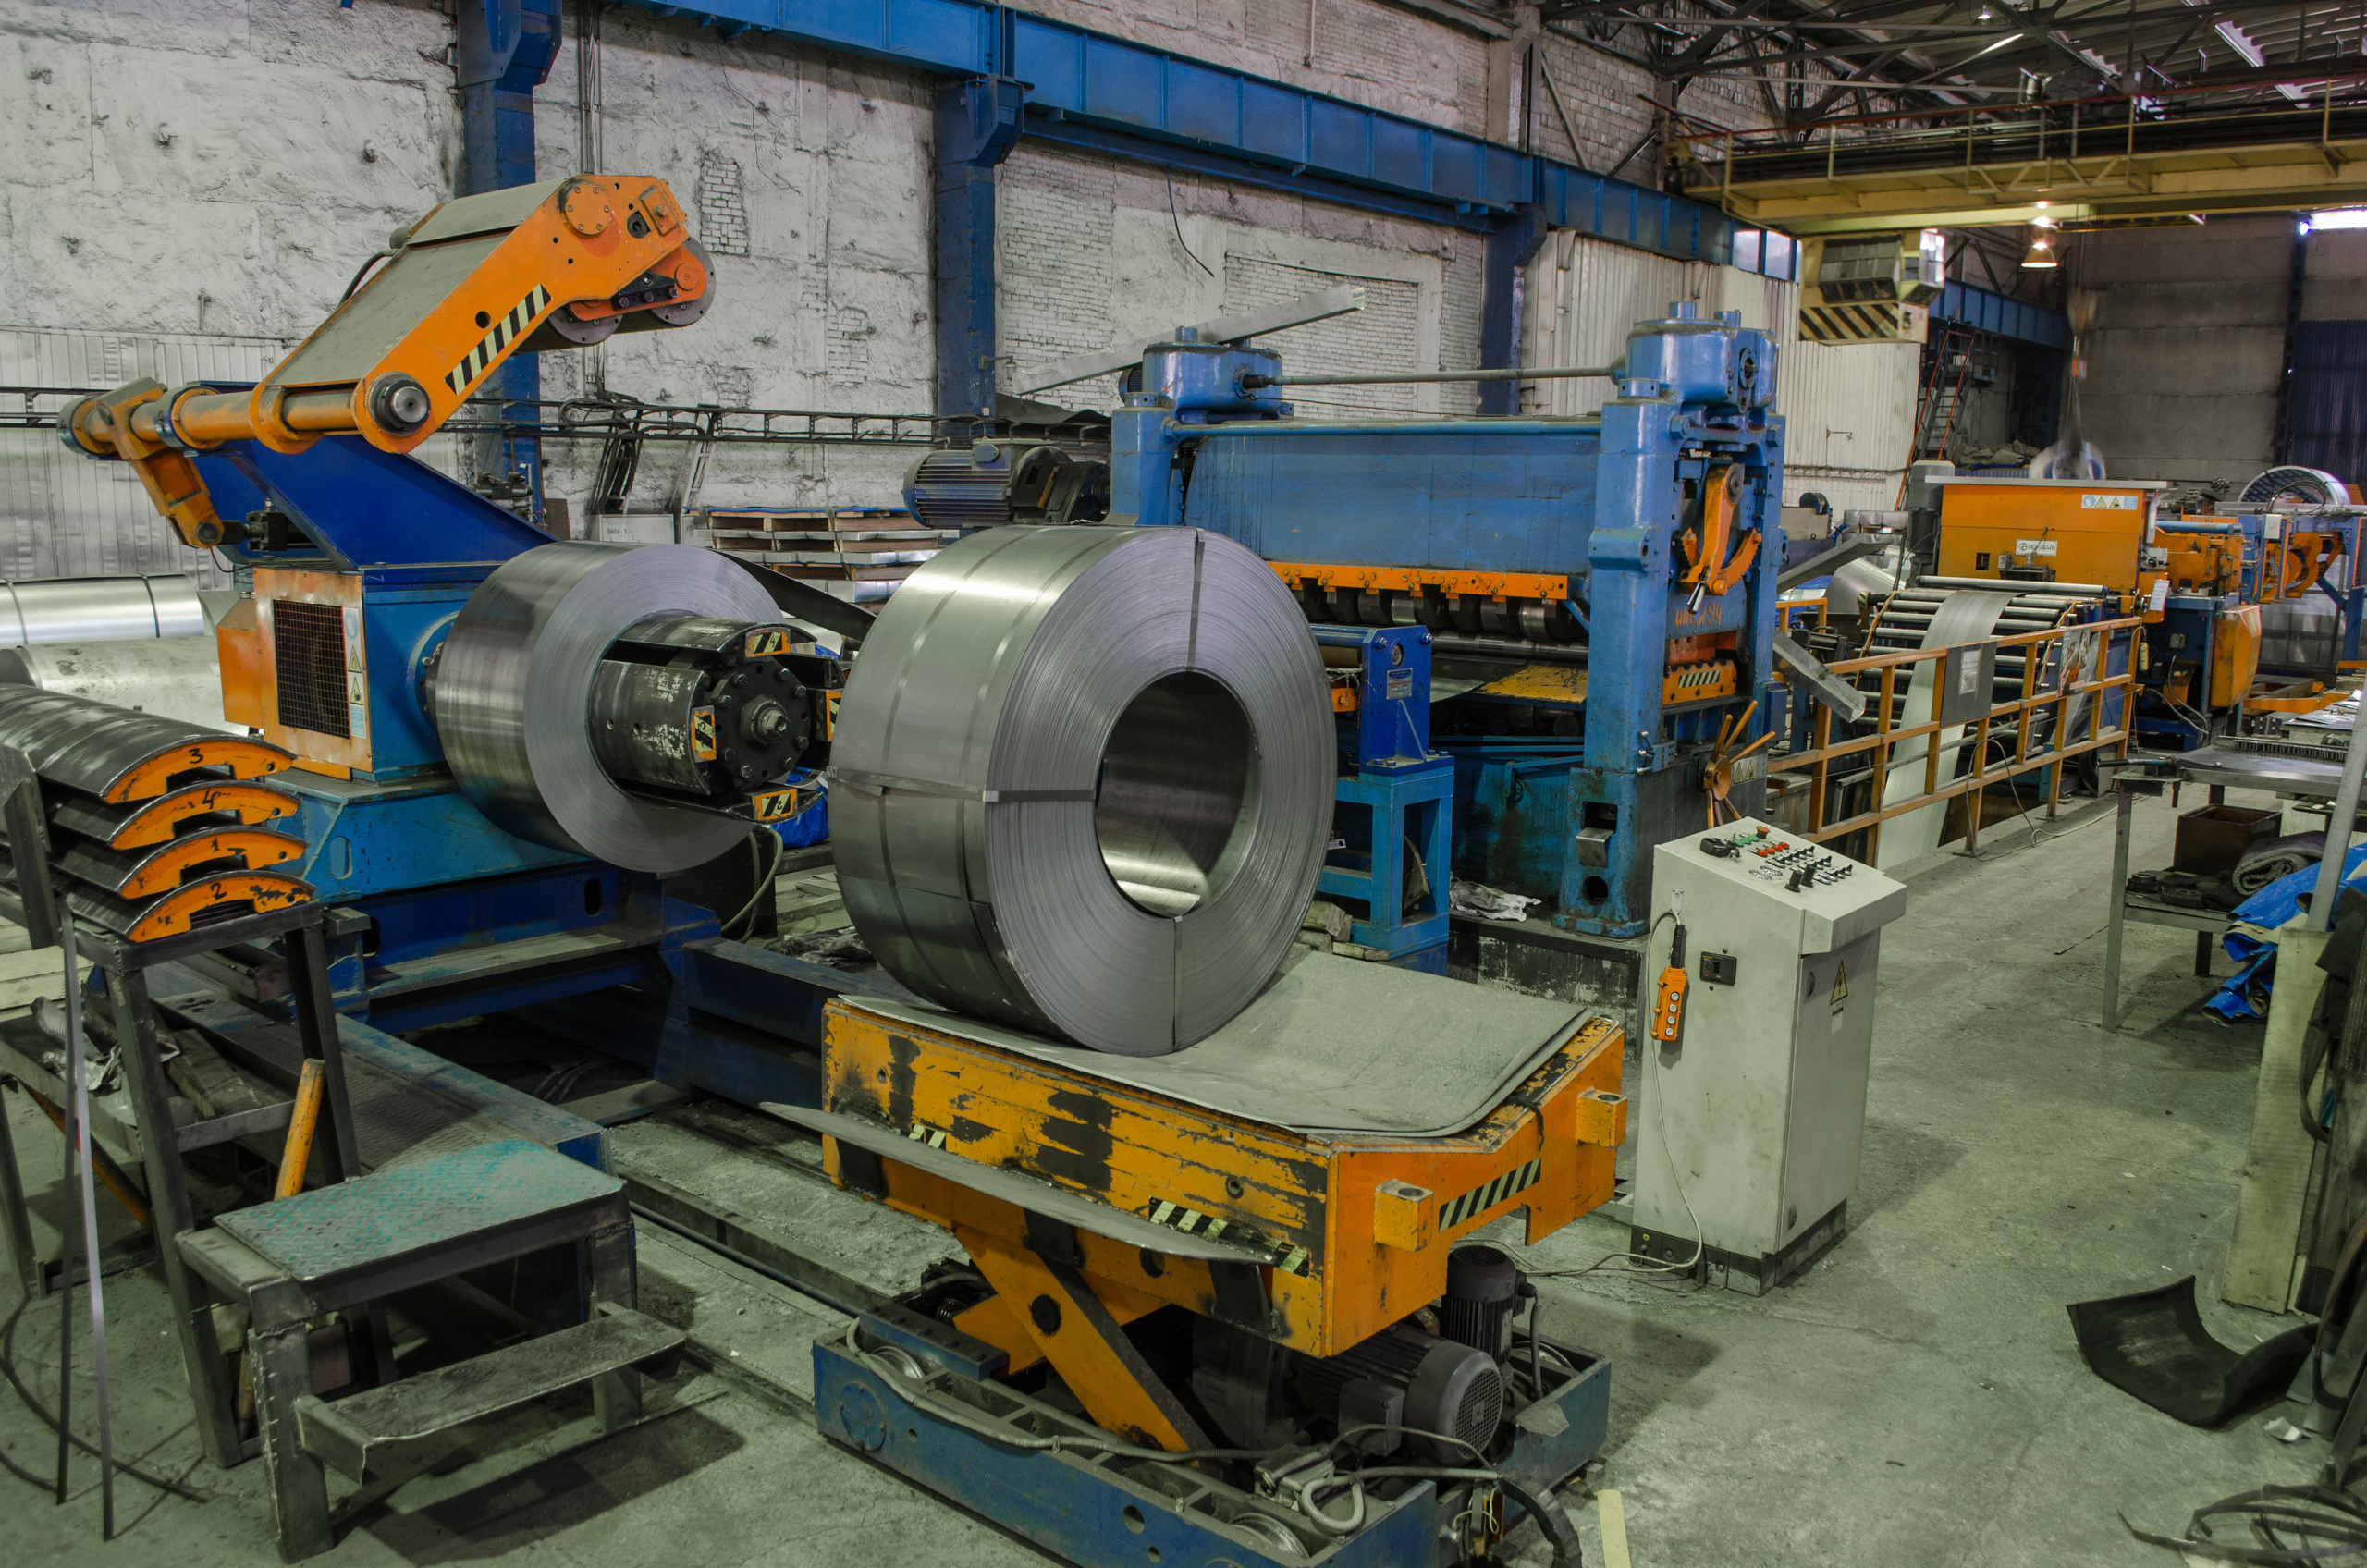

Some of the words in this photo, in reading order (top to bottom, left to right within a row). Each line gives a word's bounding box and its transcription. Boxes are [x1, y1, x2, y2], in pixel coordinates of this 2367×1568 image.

[189, 748, 204, 764] 3
[202, 789, 222, 810] 4
[212, 837, 221, 853] 1
[210, 882, 227, 900] 2
